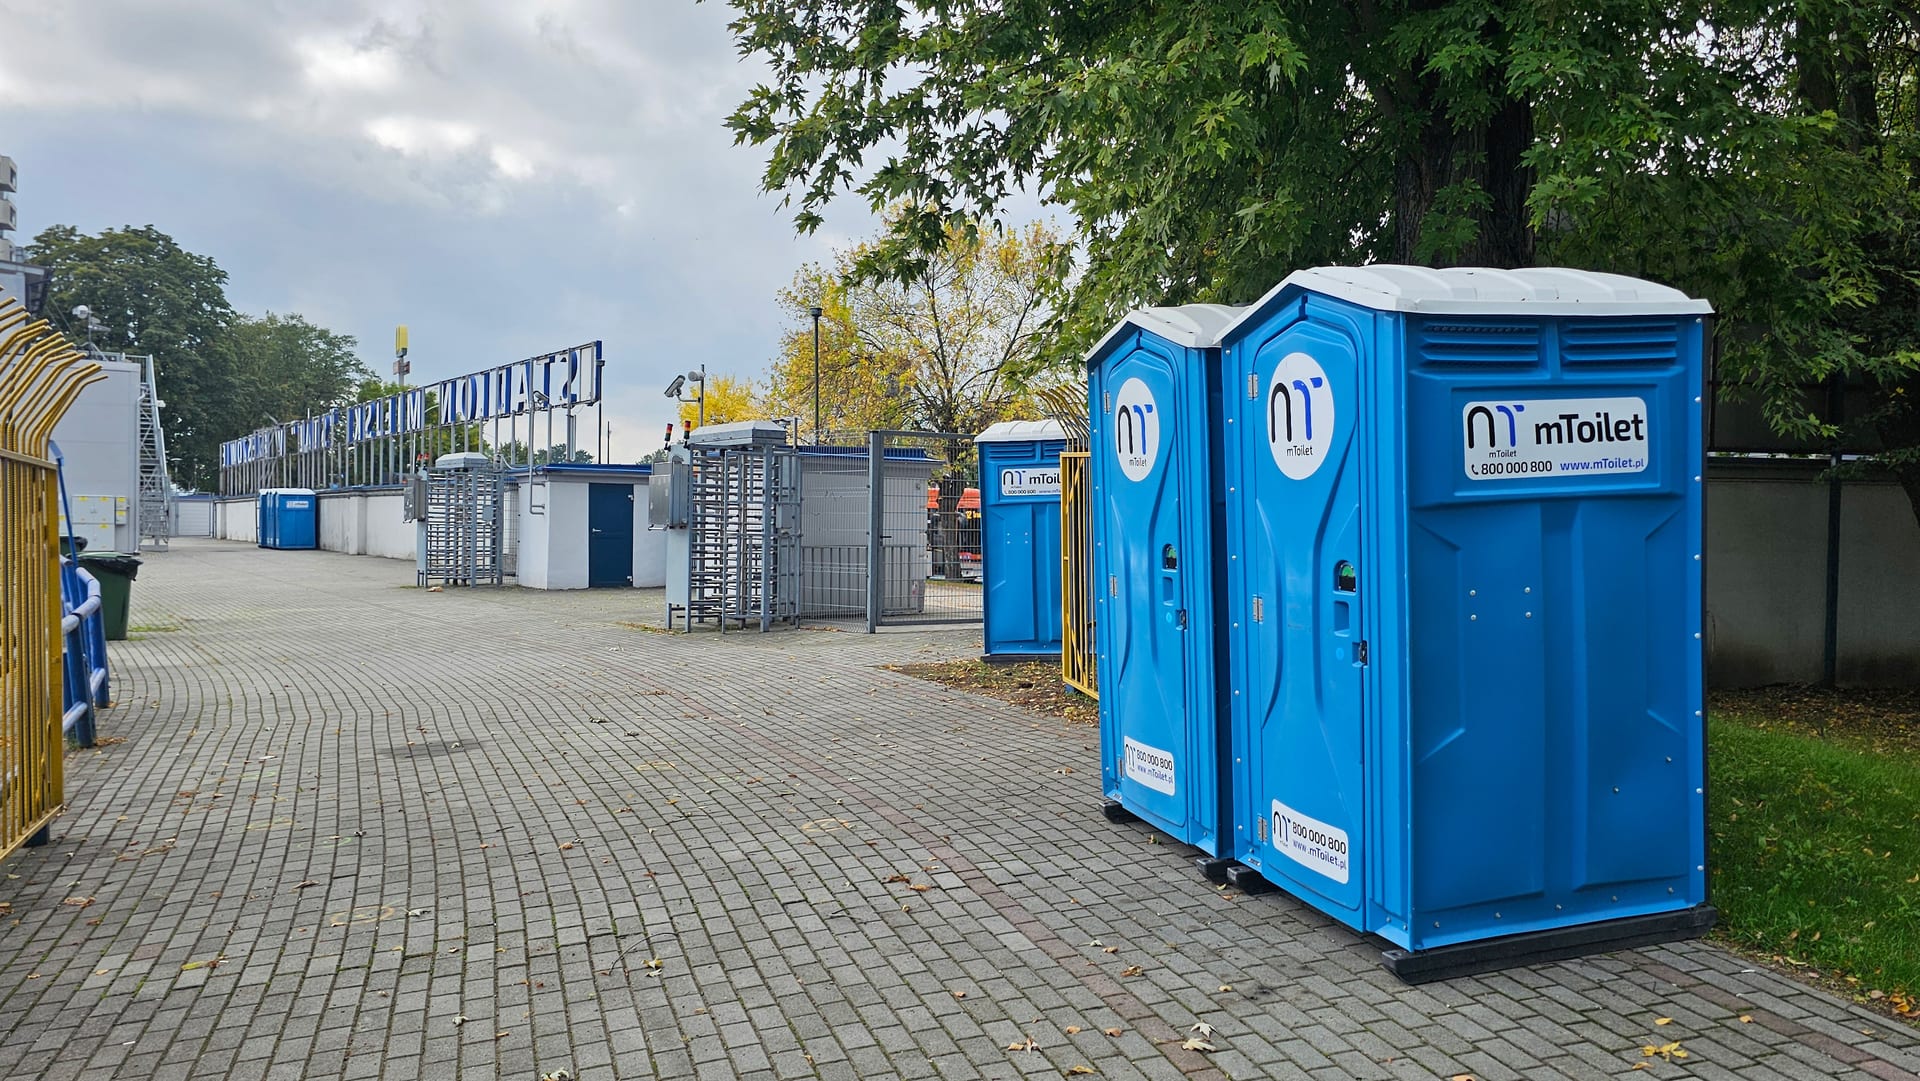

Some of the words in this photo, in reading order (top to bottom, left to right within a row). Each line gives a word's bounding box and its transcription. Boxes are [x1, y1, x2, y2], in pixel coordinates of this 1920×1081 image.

[1534, 412, 1644, 445] mToilet
[1286, 446, 1314, 457] mToilet
[1488, 449, 1517, 458] mToilet
[1481, 463, 1503, 475] 800
[1506, 462, 1528, 474] 000
[1531, 461, 1552, 472] 800
[1560, 458, 1644, 471] www.mToilet.pl
[1029, 472, 1061, 485] mToil
[1147, 753, 1159, 767] 000
[1160, 757, 1173, 771] 800
[1292, 821, 1307, 839] 800
[1308, 829, 1326, 847] 000
[1328, 837, 1347, 855] 800
